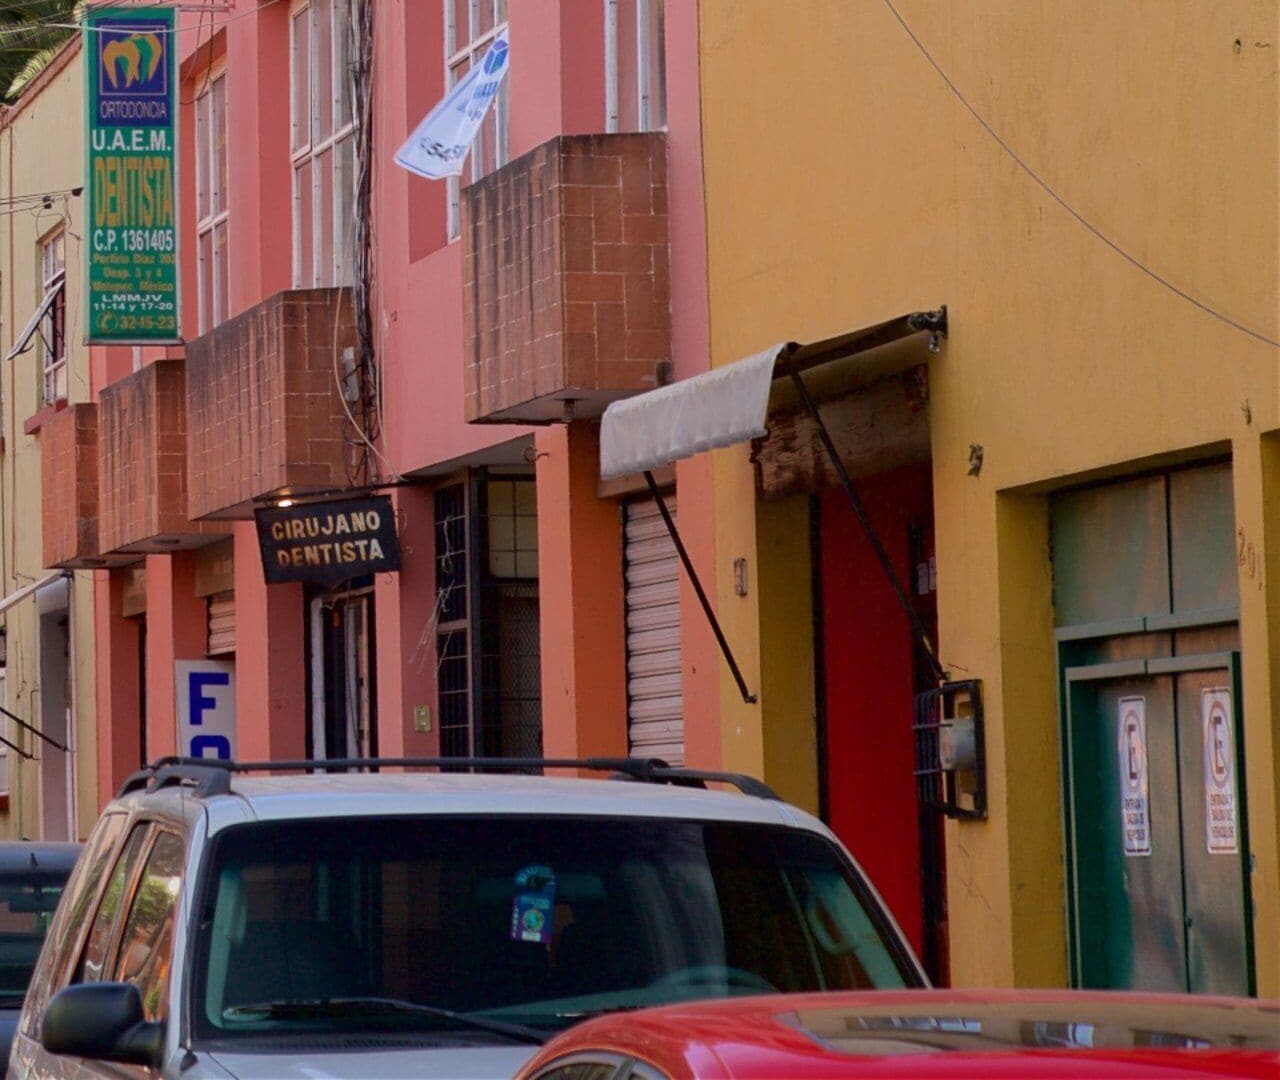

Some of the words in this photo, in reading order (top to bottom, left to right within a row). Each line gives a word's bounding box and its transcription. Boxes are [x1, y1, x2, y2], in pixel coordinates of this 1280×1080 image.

[100, 100, 167, 119] ORTODONCIA
[92, 129, 172, 152] U.A.E.M.
[95, 156, 174, 228] DENTISTA
[94, 228, 119, 252] C.P.
[121, 229, 174, 252] 1361405
[93, 303, 126, 311] 11-14
[129, 304, 137, 312] y
[141, 302, 174, 311] 17-20
[101, 294, 163, 302] LMMJV
[271, 510, 381, 541] CIRUJANO
[276, 537, 385, 568] DENTISTA
